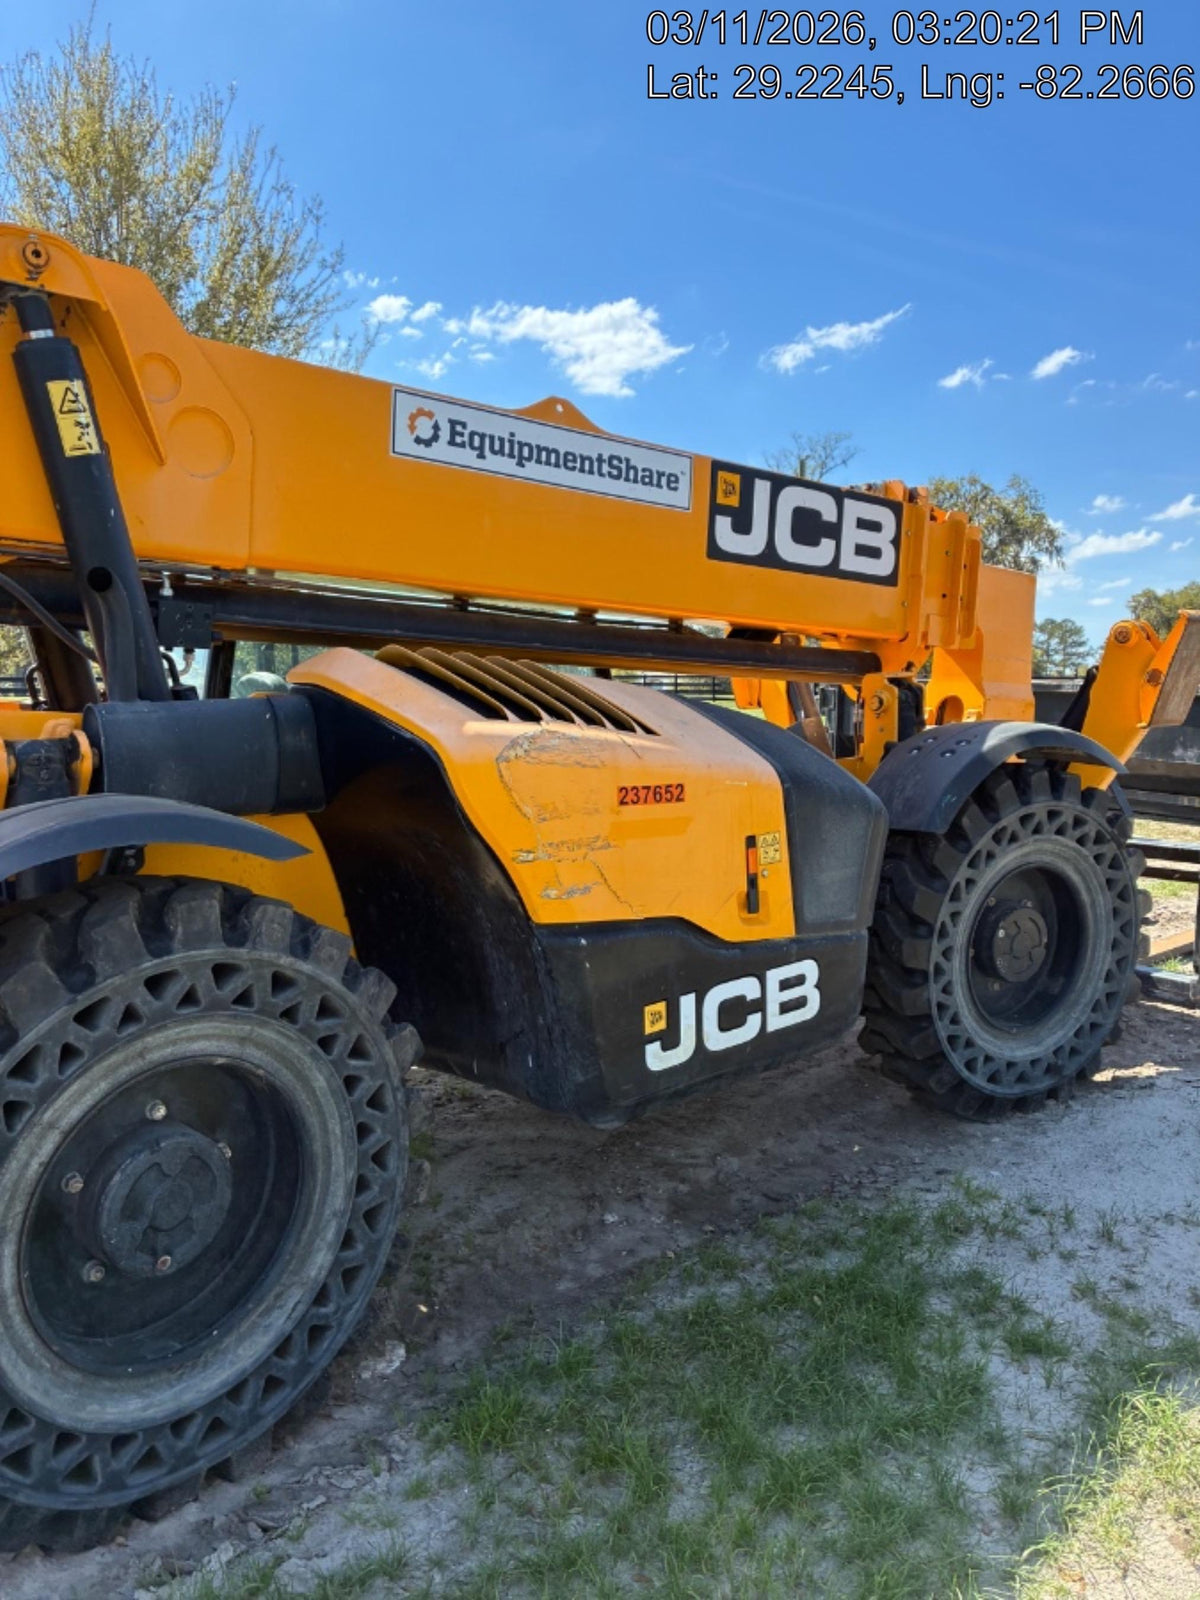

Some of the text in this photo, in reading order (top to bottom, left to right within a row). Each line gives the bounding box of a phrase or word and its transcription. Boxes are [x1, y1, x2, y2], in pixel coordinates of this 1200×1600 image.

[447, 417, 681, 492] EquipmentShare
[714, 478, 897, 577] JCB
[618, 783, 685, 806] 237652
[644, 958, 821, 1071] JCB
